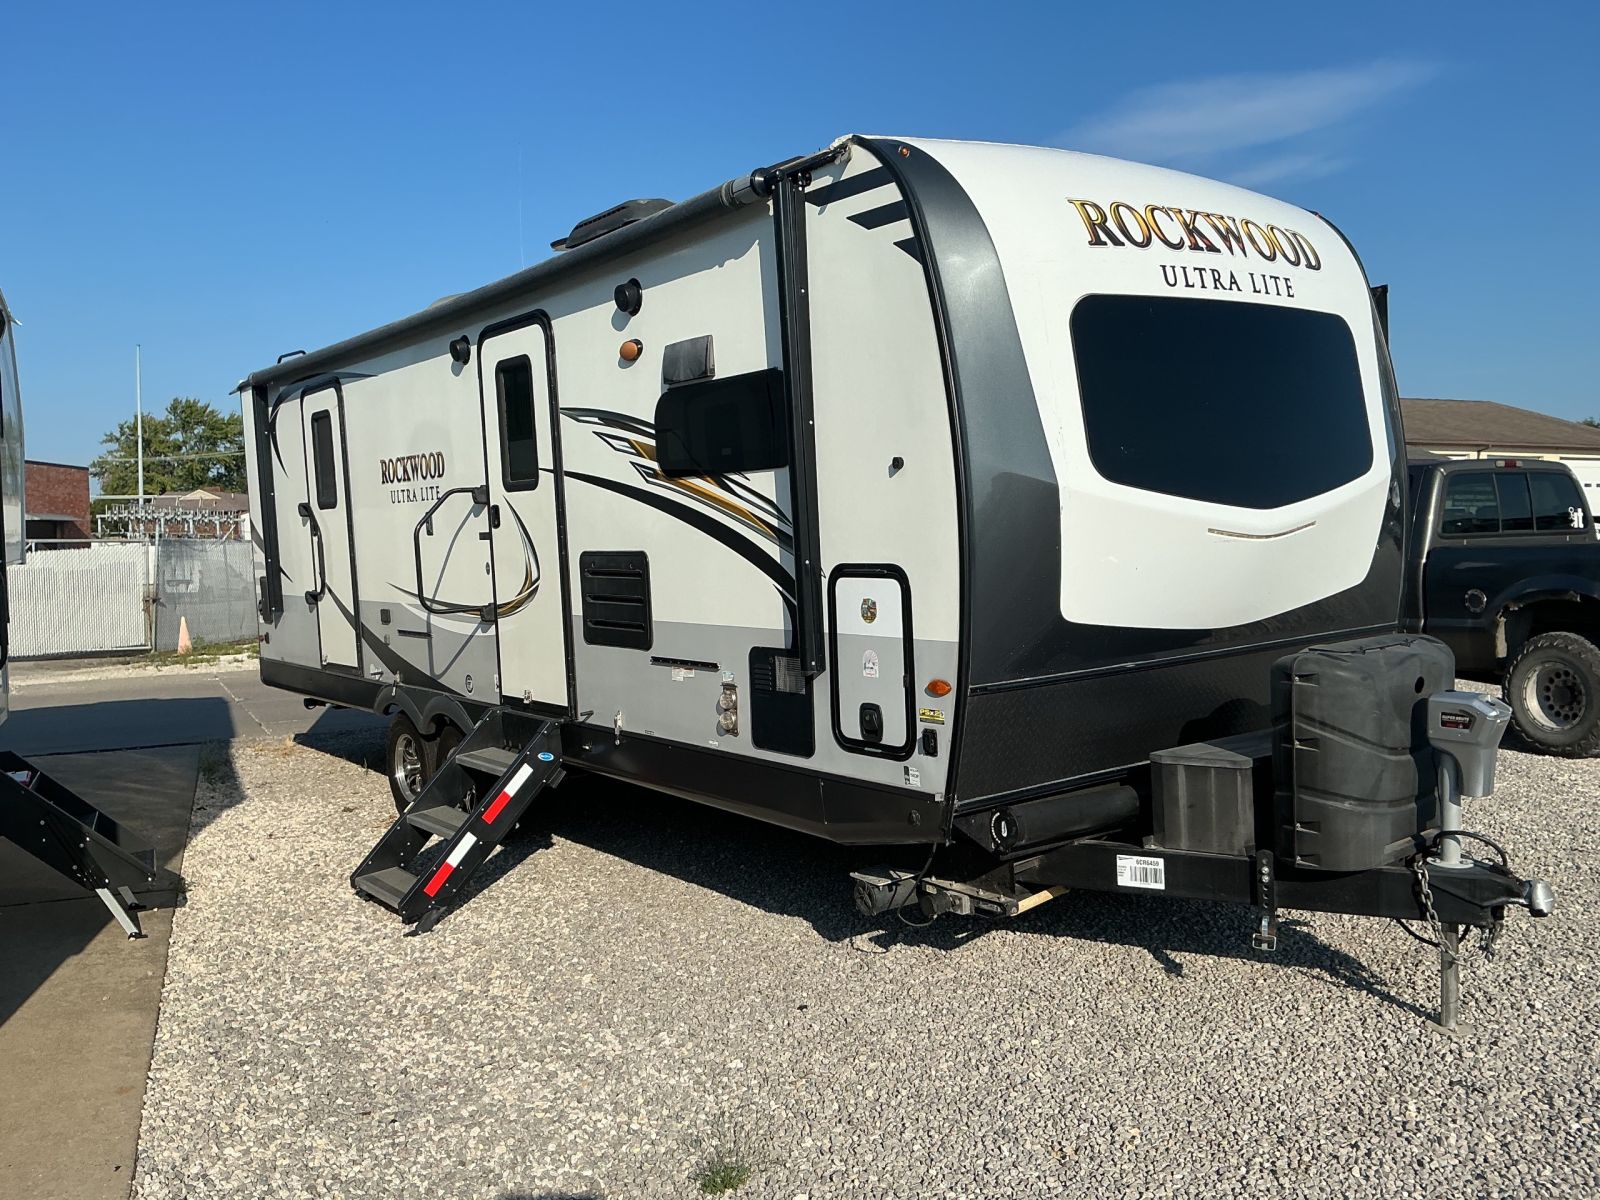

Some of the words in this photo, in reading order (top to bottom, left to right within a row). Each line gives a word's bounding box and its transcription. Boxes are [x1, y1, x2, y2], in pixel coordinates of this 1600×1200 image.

[1067, 198, 1321, 271] ROCKWOOD
[1160, 265, 1242, 292] ULTRA
[1248, 272, 1295, 298] LITE
[380, 451, 445, 485] ROCKWOOD
[390, 488, 417, 504] ULTRA
[420, 486, 440, 502] LITE
